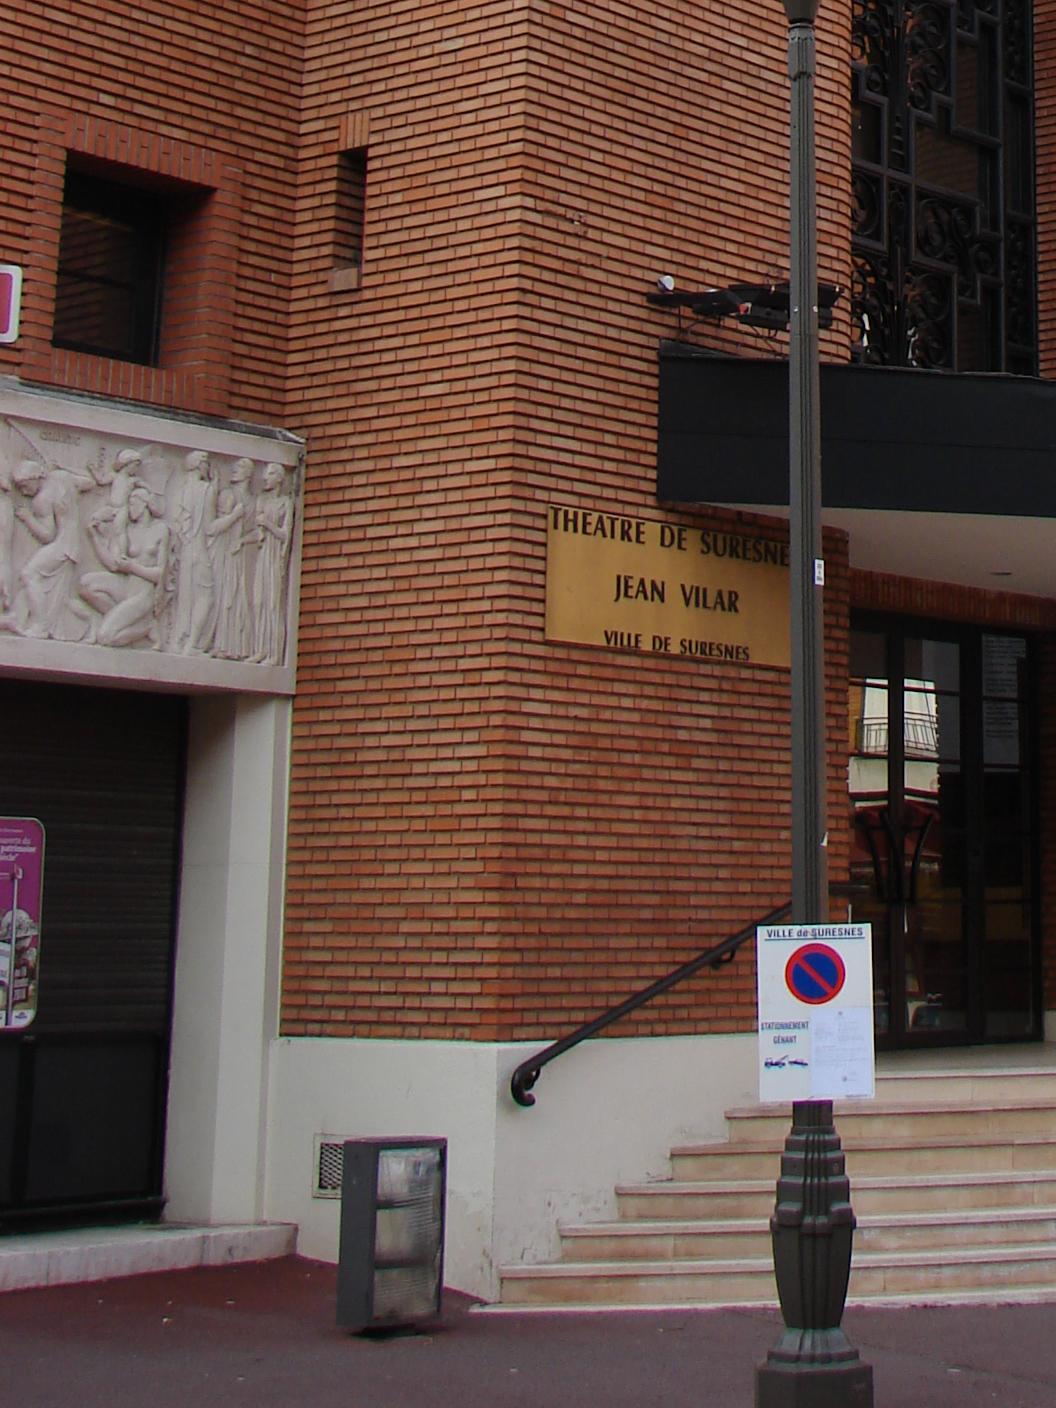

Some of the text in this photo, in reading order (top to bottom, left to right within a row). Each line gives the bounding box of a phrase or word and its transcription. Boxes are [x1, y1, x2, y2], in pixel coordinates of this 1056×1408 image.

[551, 506, 789, 566] THEATRE DE SURESNE
[614, 574, 740, 613] JEAN VILAR
[604, 630, 750, 661] VILLE DE SURESNES
[766, 927, 864, 938] VILLE de SURESNES
